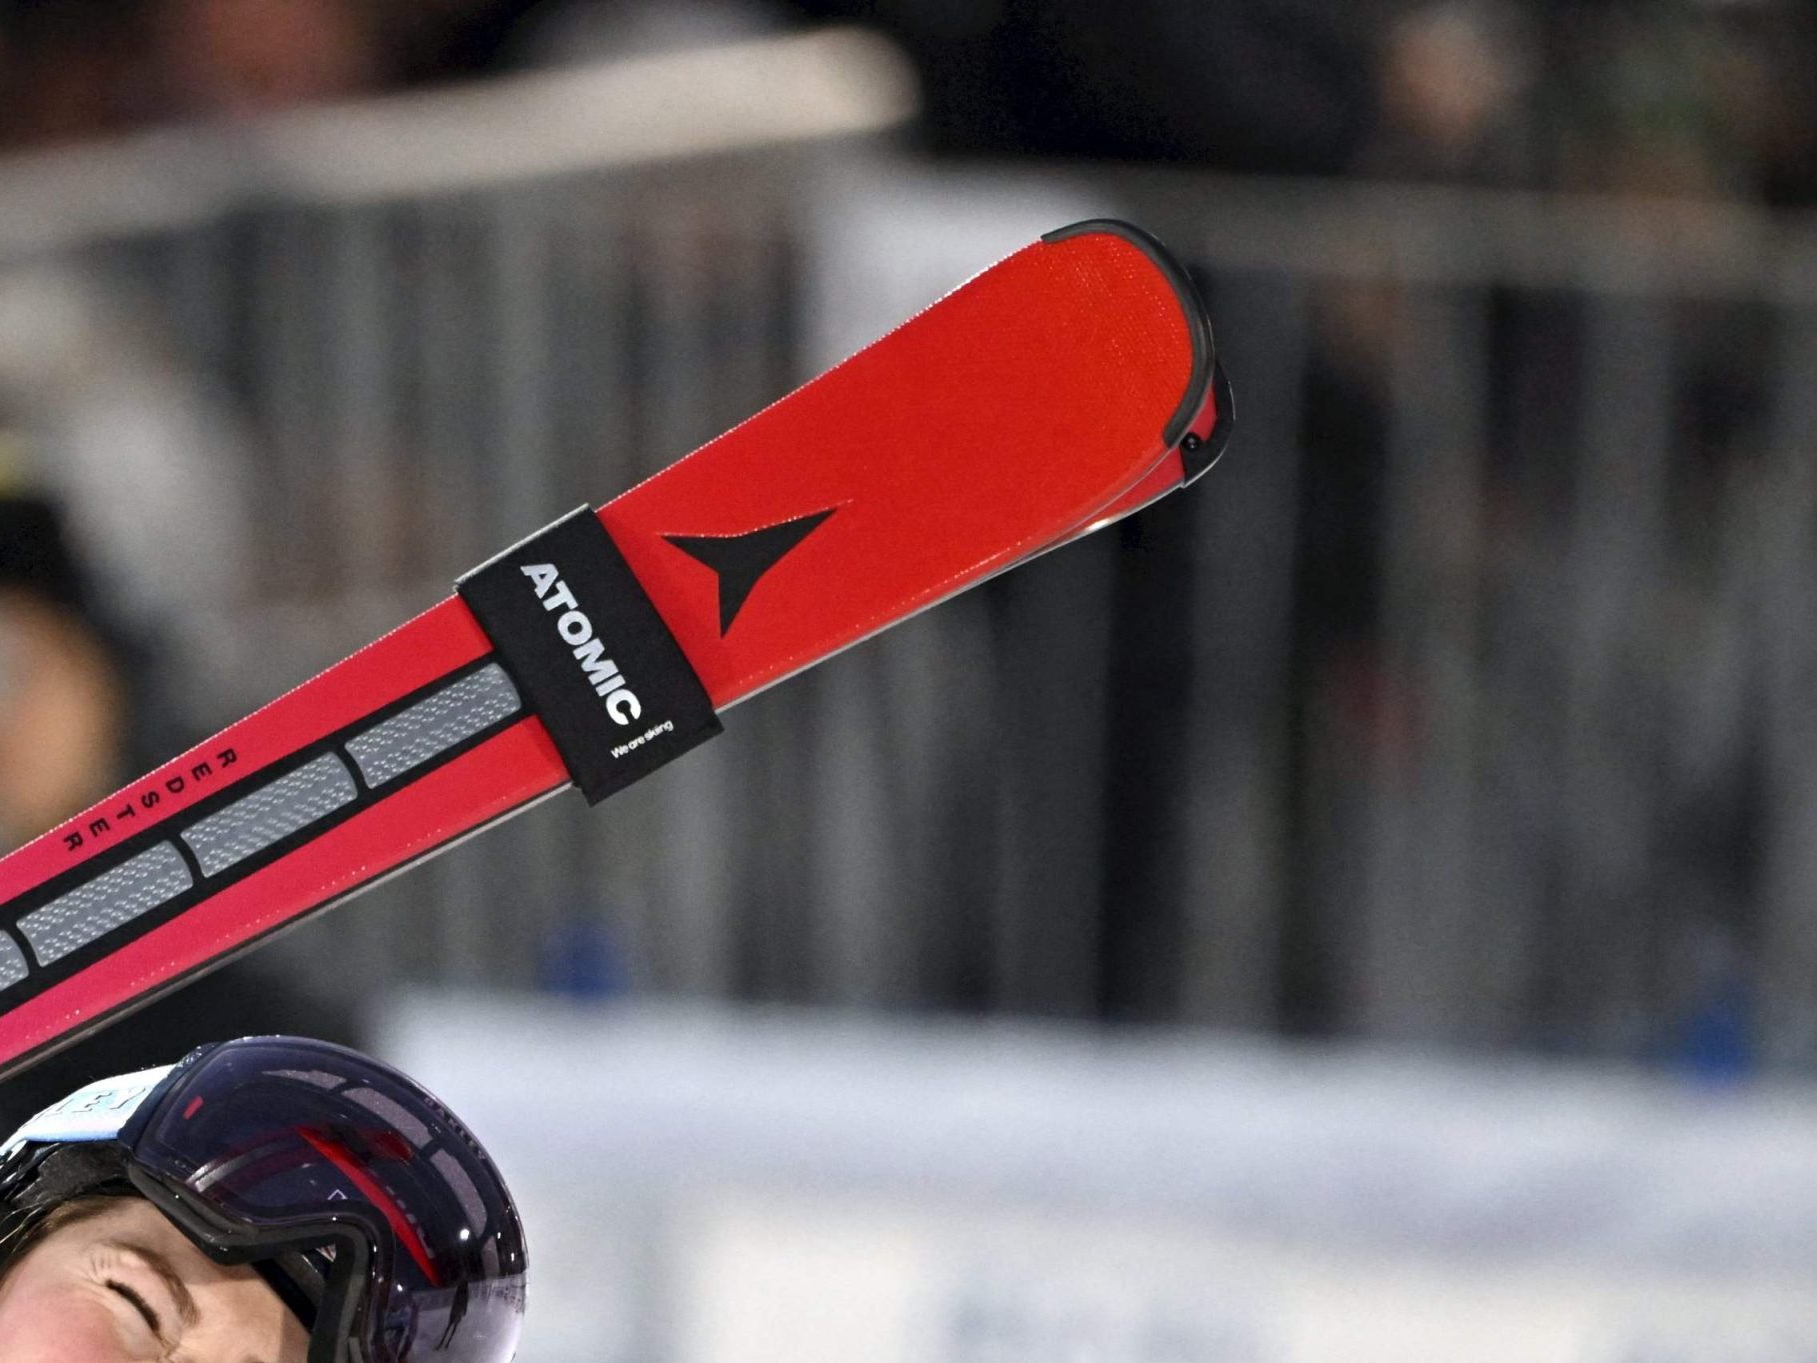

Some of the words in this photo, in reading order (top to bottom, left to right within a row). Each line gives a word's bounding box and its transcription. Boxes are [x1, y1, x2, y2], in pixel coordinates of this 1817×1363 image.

[520, 562, 643, 727] ATOMIC
[610, 745, 629, 759] We
[628, 736, 646, 750] are
[644, 720, 674, 741] skiing
[63, 748, 238, 851] REDSTER
